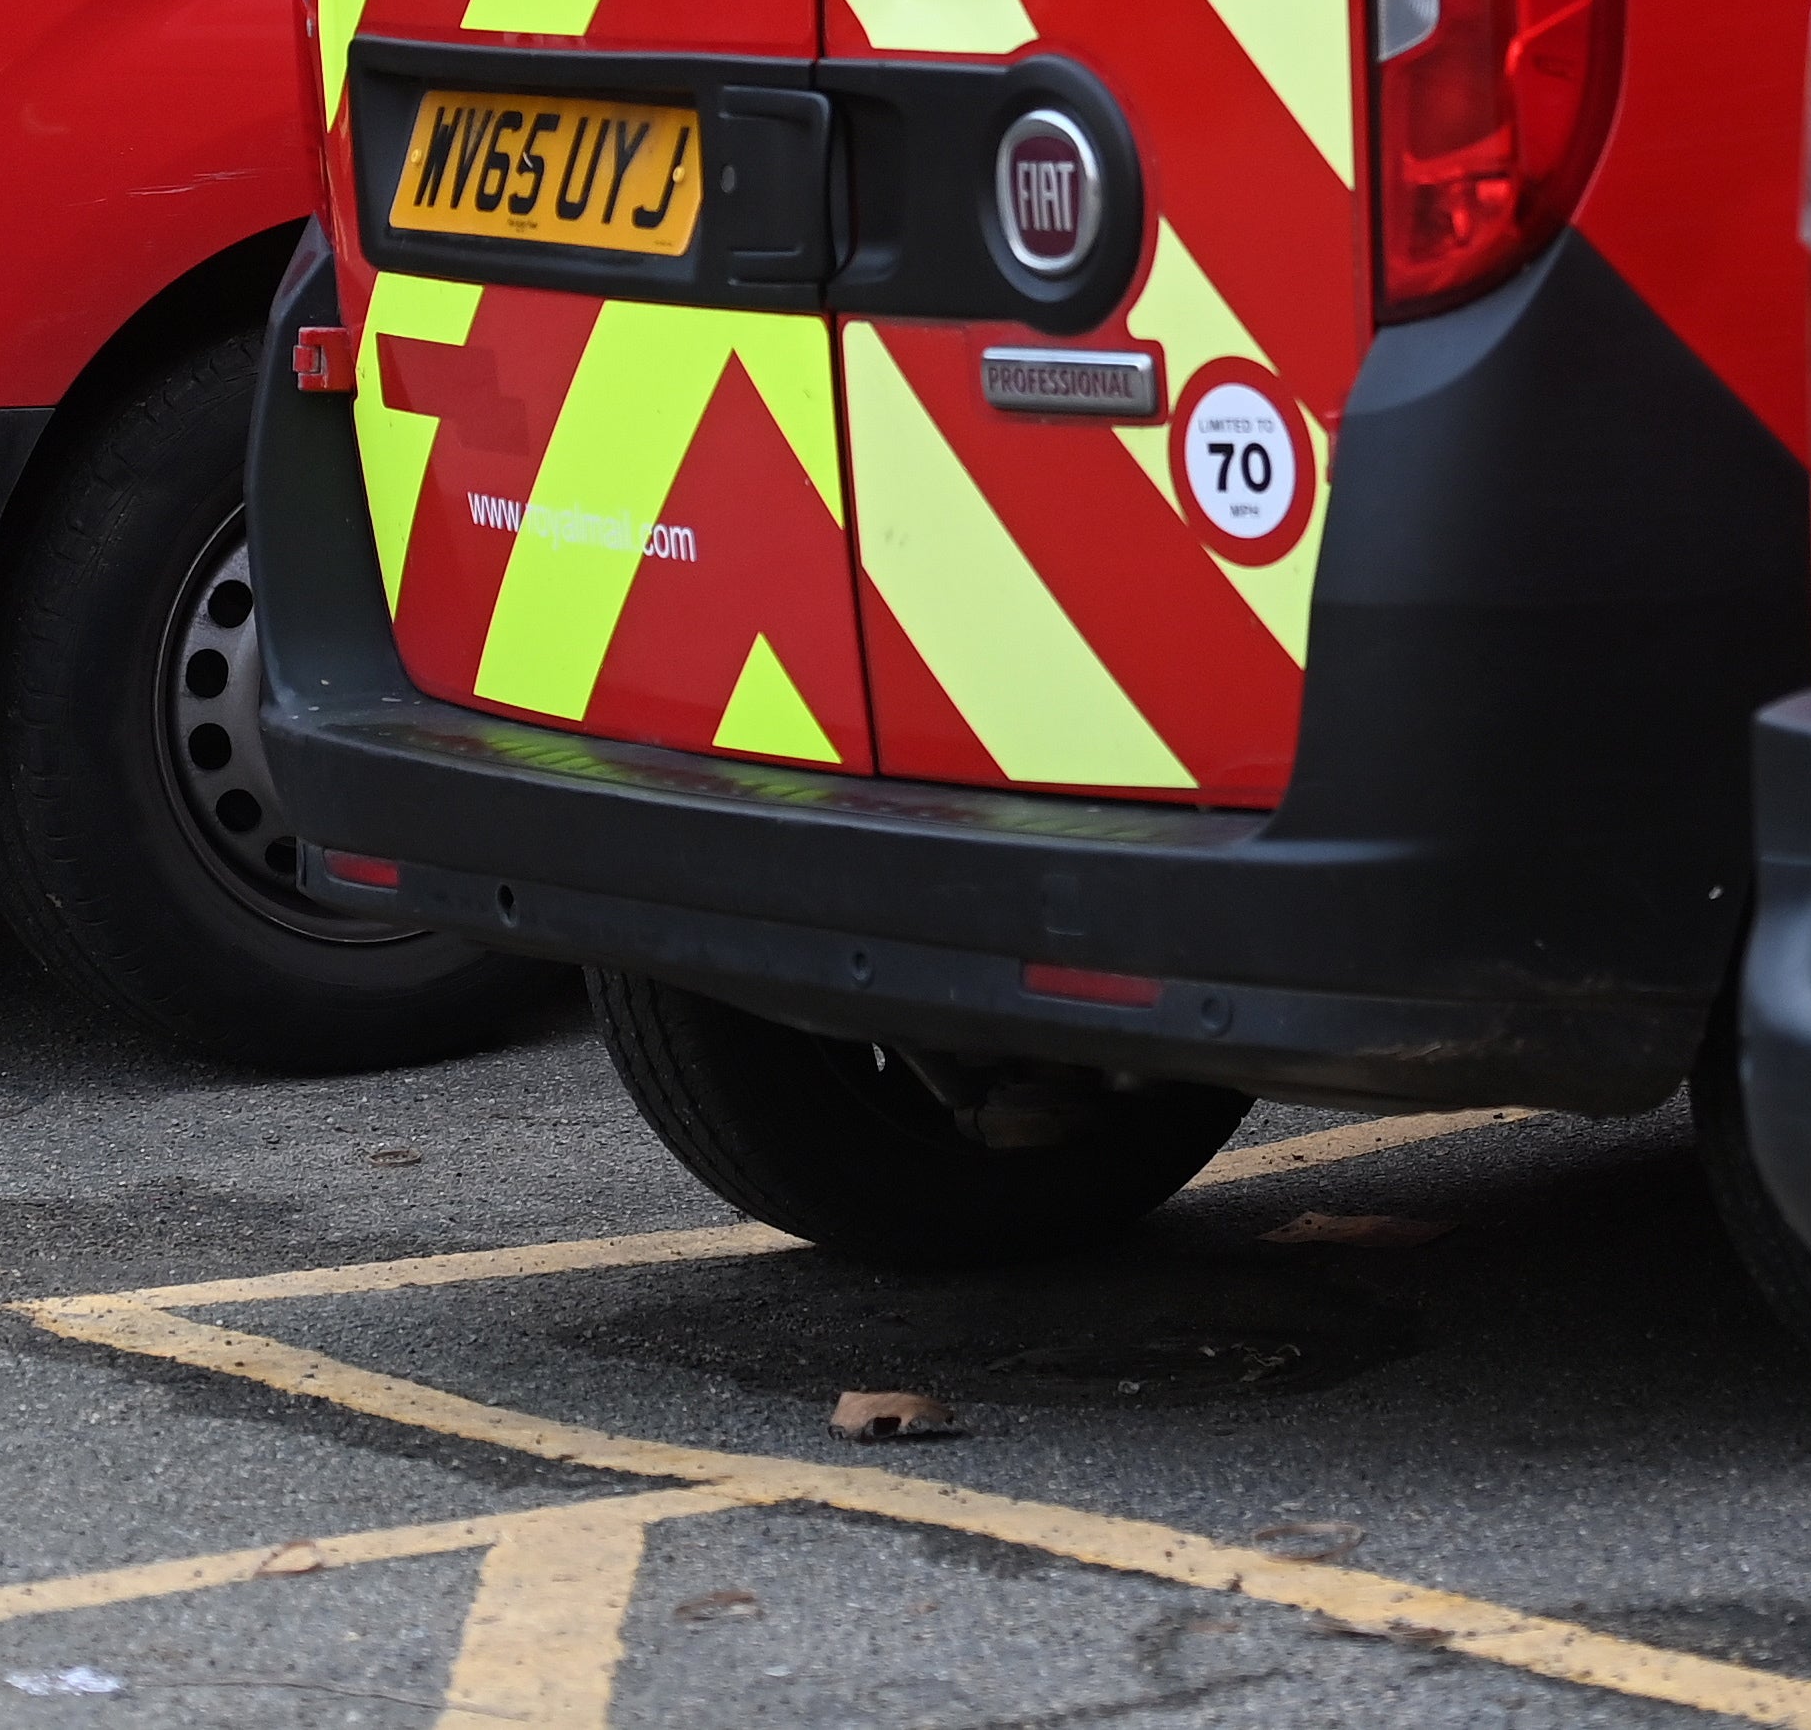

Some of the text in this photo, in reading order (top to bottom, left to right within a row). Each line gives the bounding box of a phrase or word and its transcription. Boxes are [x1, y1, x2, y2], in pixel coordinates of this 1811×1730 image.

[413, 106, 690, 230] WV65 UYJ
[1016, 160, 1074, 232] FIAT
[990, 366, 1133, 400] PROFESSIONAL
[1198, 419, 1275, 435] LIMITED TO
[1207, 442, 1272, 493] 70
